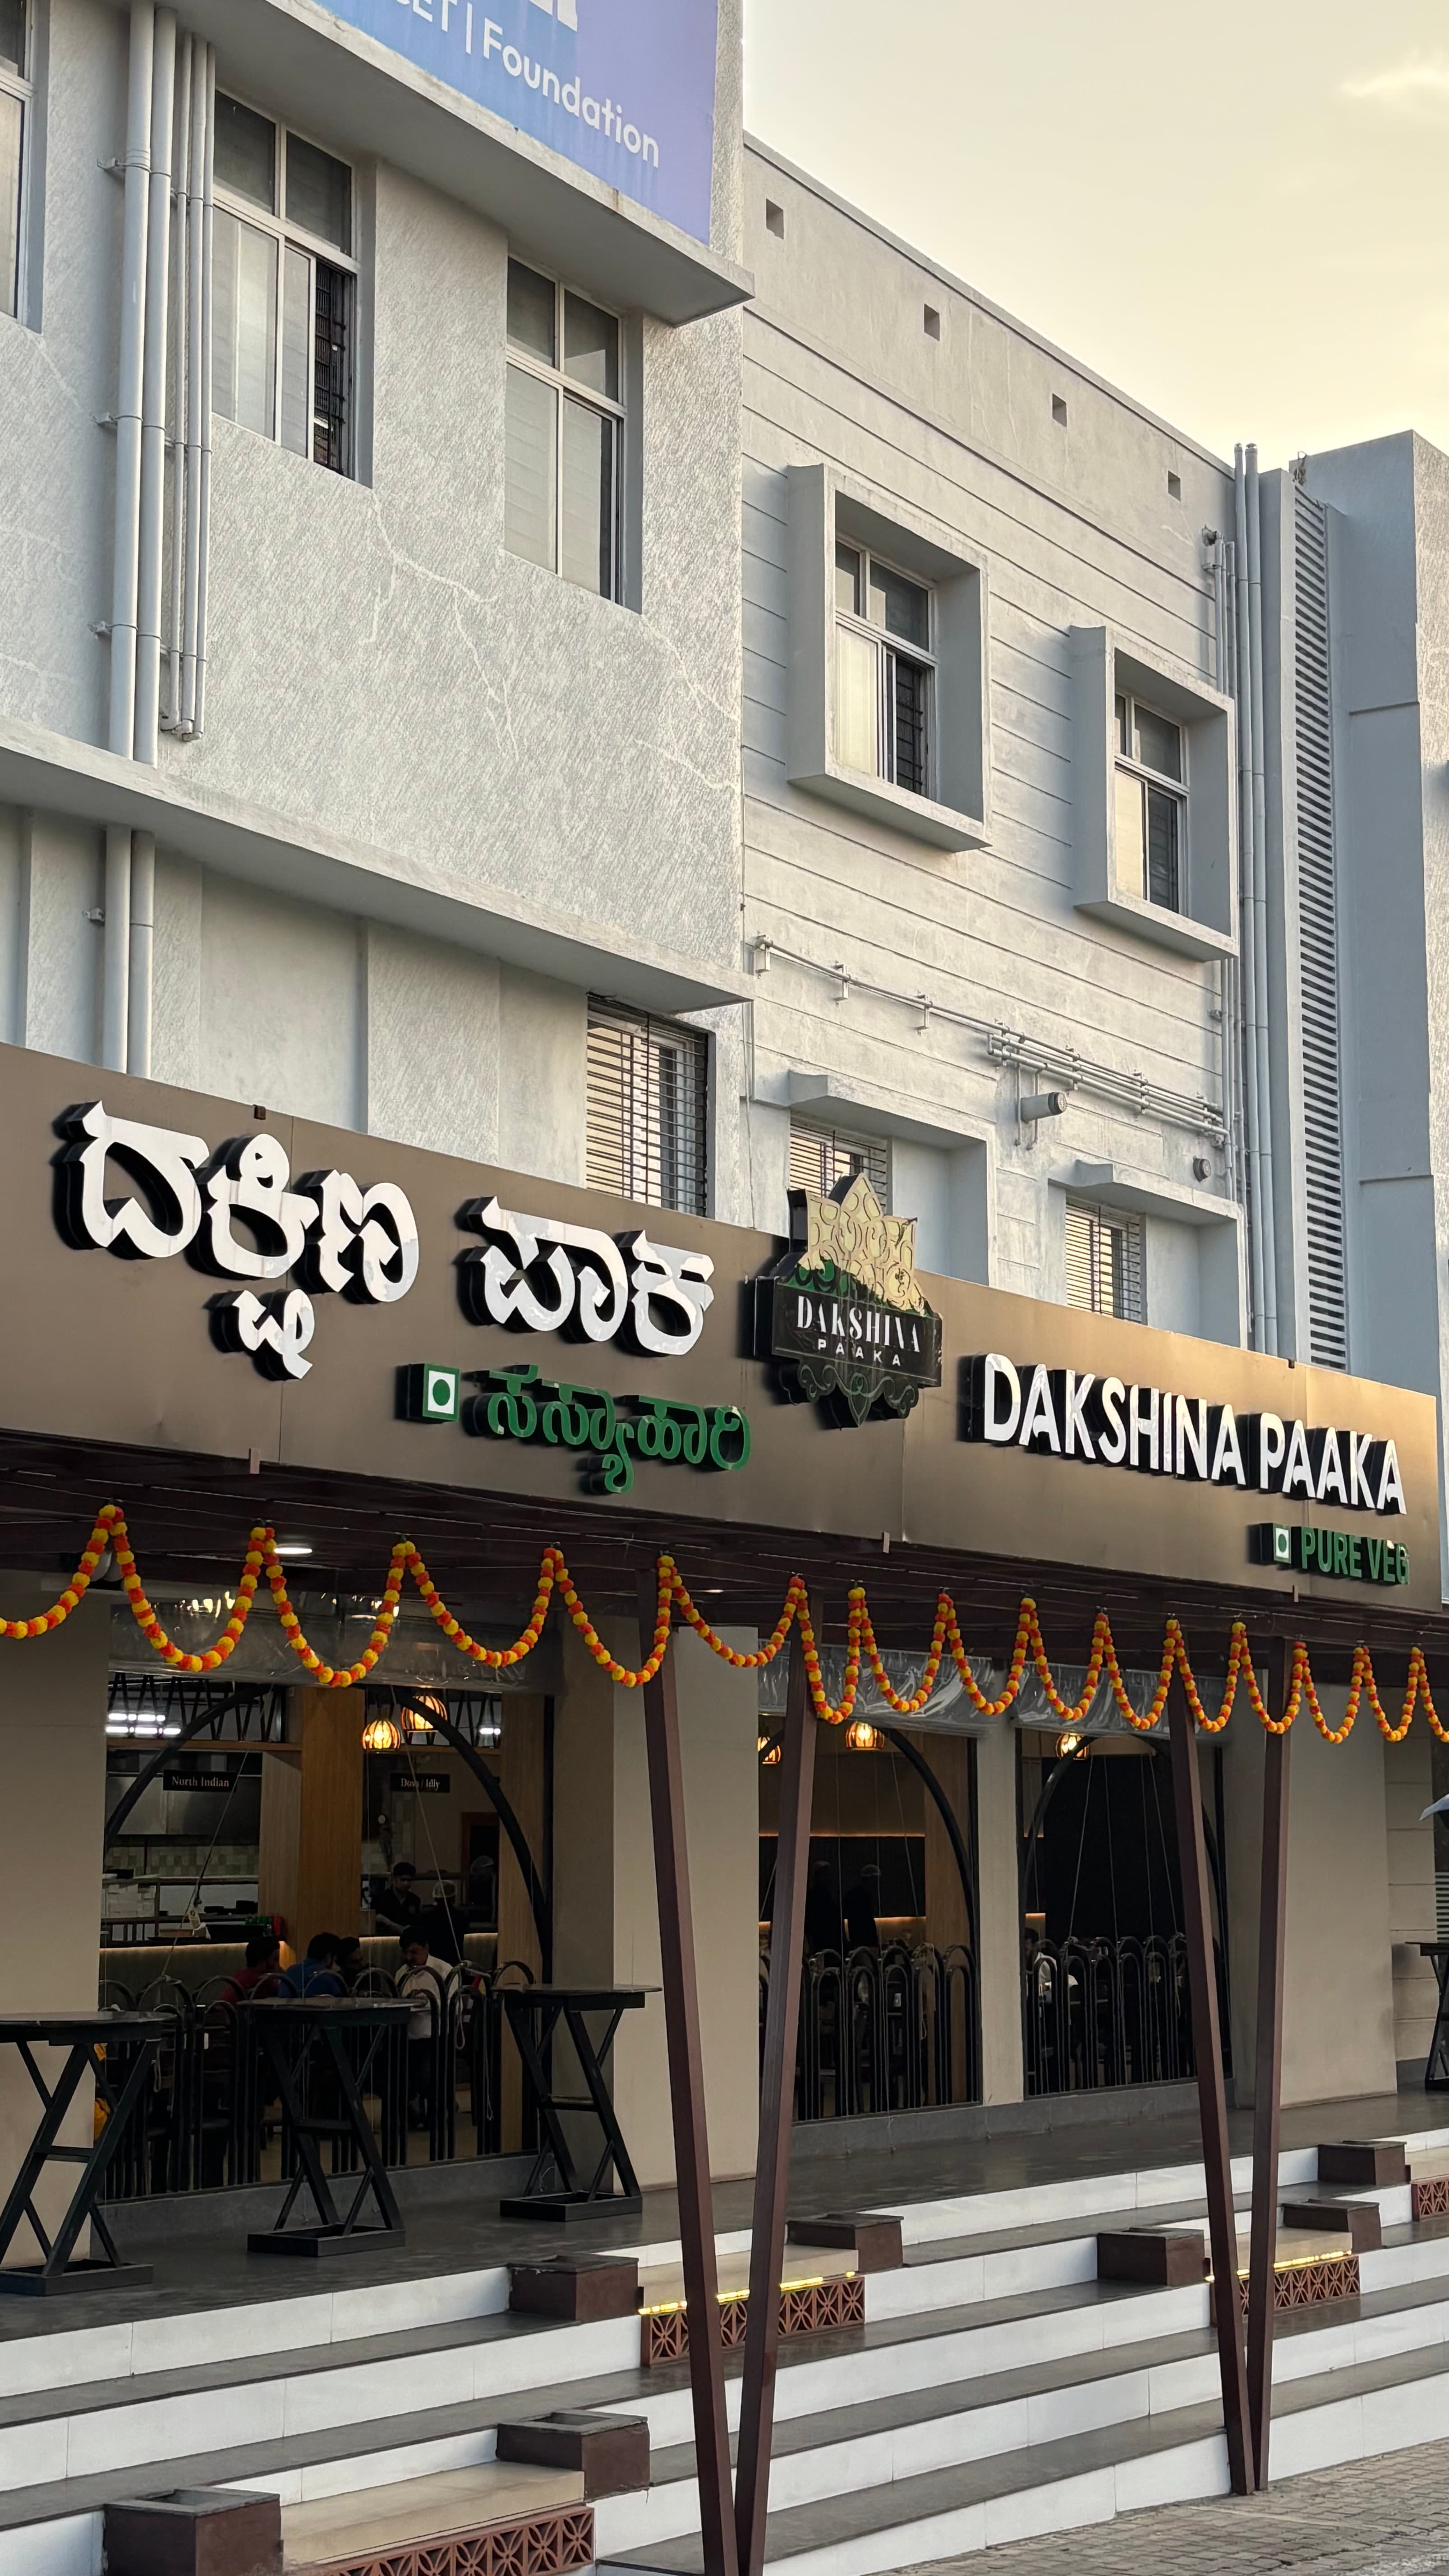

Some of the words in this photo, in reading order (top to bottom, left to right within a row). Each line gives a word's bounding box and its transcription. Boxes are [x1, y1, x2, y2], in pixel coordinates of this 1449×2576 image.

[483, 18, 659, 167] Foundation
[80, 1100, 419, 1379] ದಕ್ಷಿಣ
[480, 1196, 714, 1355] ಪಾಕ
[797, 1295, 920, 1352] DAKSHINA
[818, 1338, 901, 1366] PAAKA
[488, 1365, 752, 1494] ಸಸ್ಯಾಹಾರಿ
[984, 1353, 1246, 1486] DAKSHINA
[1260, 1412, 1407, 1514] PAAKA
[1301, 1527, 1362, 1578] PURE
[1367, 1537, 1410, 1584] VEG
[172, 1776, 198, 1786] North
[201, 1776, 229, 1787] Indian
